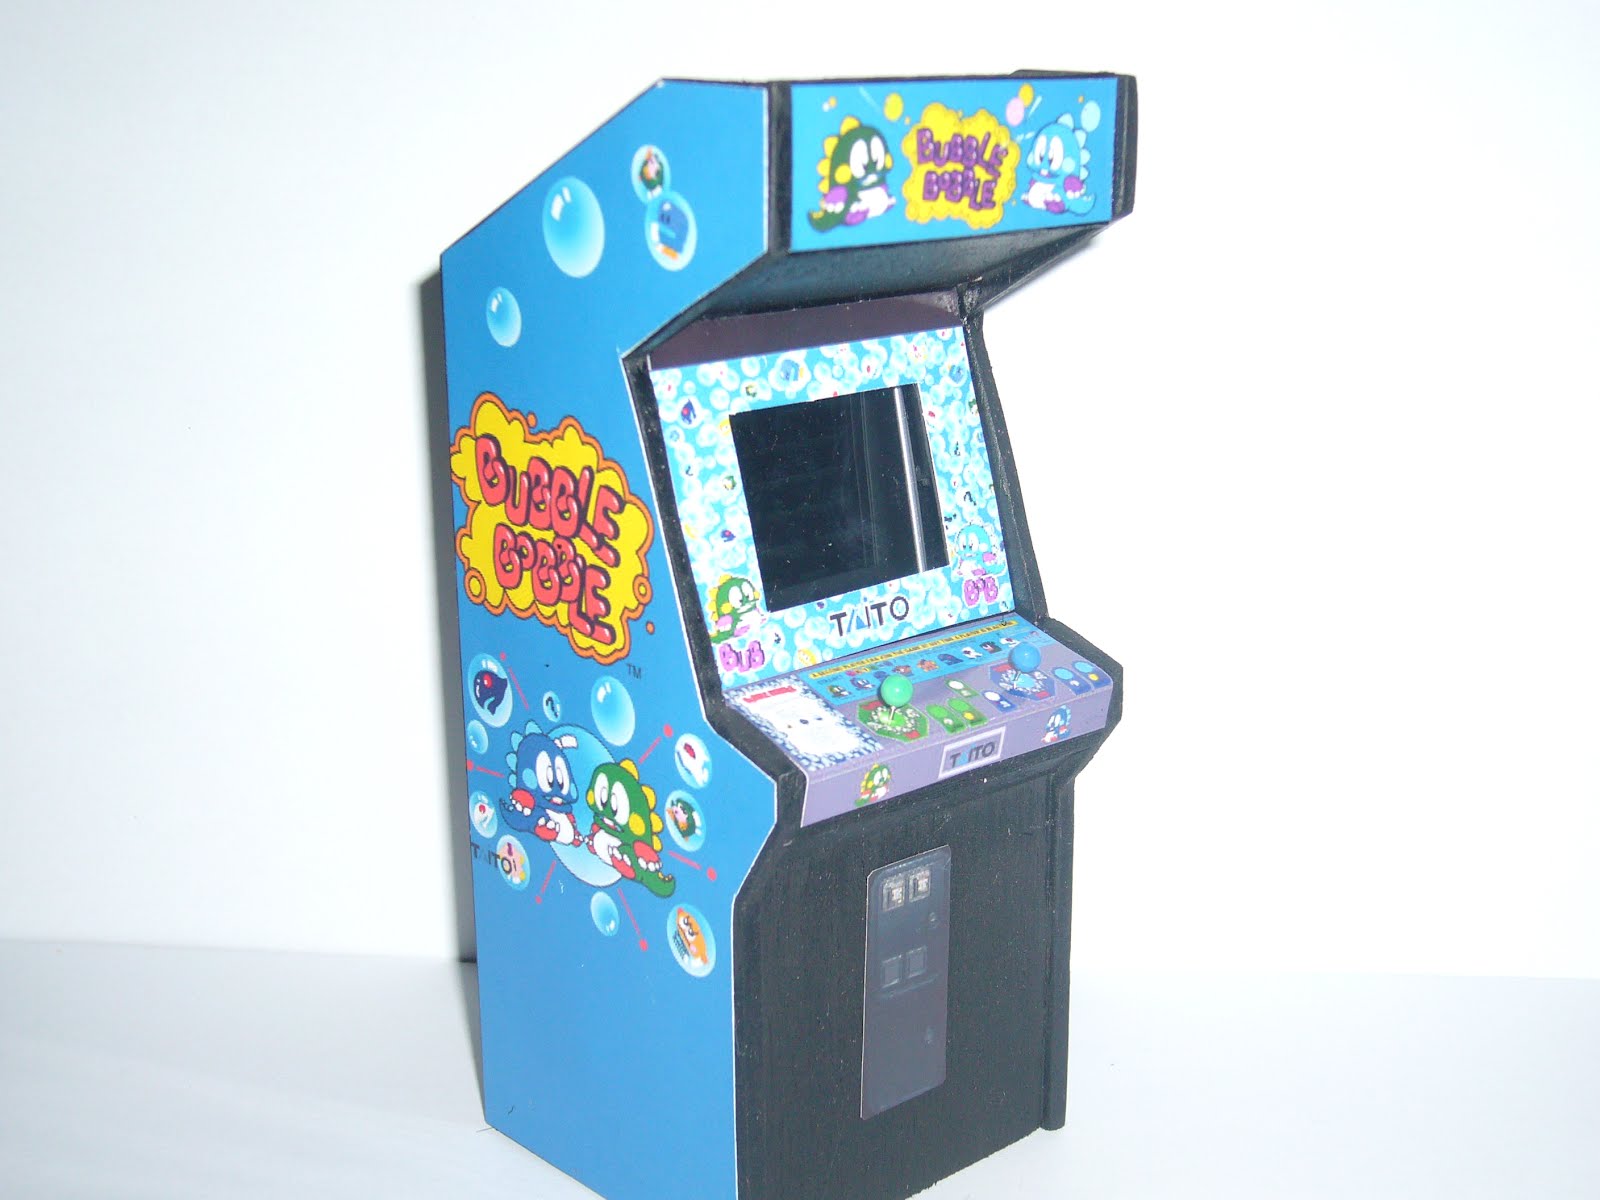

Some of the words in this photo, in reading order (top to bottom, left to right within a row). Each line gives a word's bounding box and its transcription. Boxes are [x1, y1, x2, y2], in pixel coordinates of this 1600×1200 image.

[917, 128, 1008, 179] BUBBLE
[922, 169, 997, 211] BOBBLE
[475, 433, 625, 568] BUBBLE
[493, 523, 617, 645] BOBBLE
[963, 576, 999, 607] BOB
[830, 596, 909, 637] TAITO
[626, 662, 642, 680] TM
[718, 640, 766, 673] BUB
[950, 742, 996, 769] TAITO
